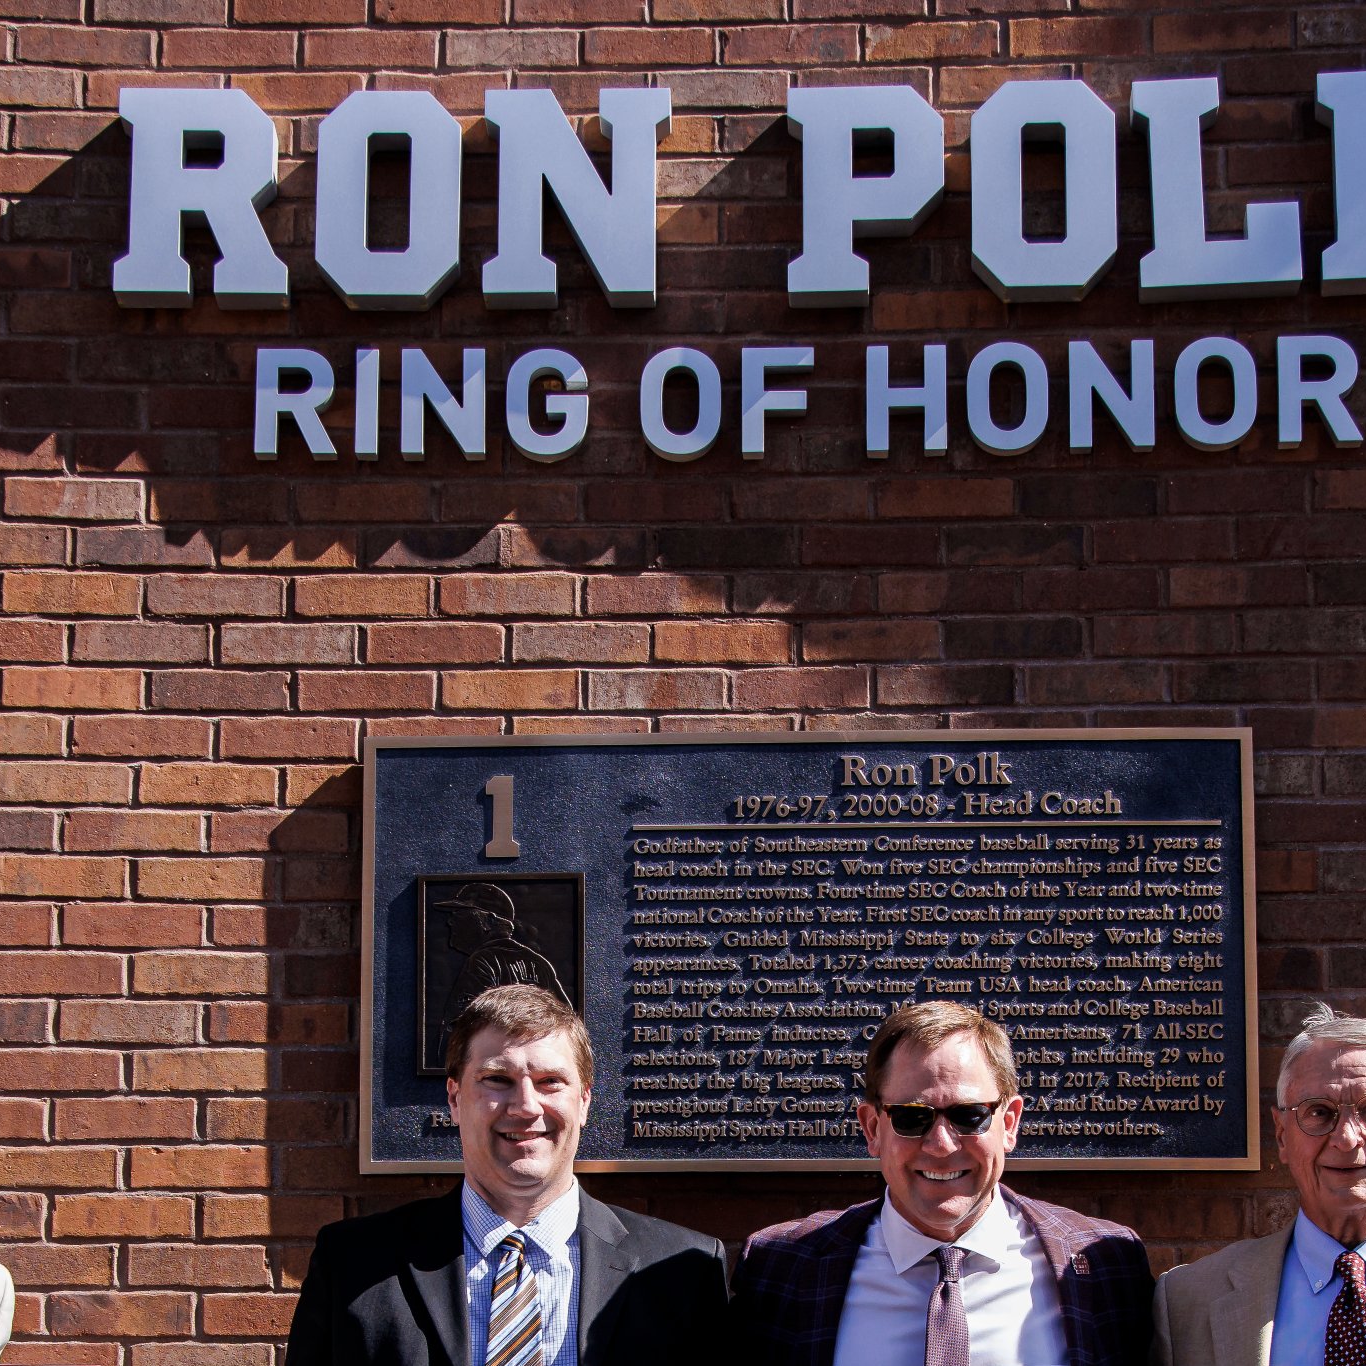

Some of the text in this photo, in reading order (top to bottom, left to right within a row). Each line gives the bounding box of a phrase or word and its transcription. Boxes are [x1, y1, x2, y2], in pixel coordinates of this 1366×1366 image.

[113, 88, 672, 310] RON
[254, 334, 1362, 463] RING OF HONOR
[841, 752, 1013, 787] Ron Polk
[485, 776, 520, 858] 1
[734, 796, 837, 822] 1976-97,
[843, 795, 939, 818] 2000-08
[964, 792, 1033, 816] Head
[1040, 791, 1122, 815] Coach
[633, 834, 1222, 855] Godfather of Southeastern Conference baseball serving 31 years as
[633, 857, 1221, 879] head coach in the SEC. Won five SEC championships and five SEC
[633, 881, 1223, 900] Tournament crowns. Four-time SEC Coach of the Year and two-time
